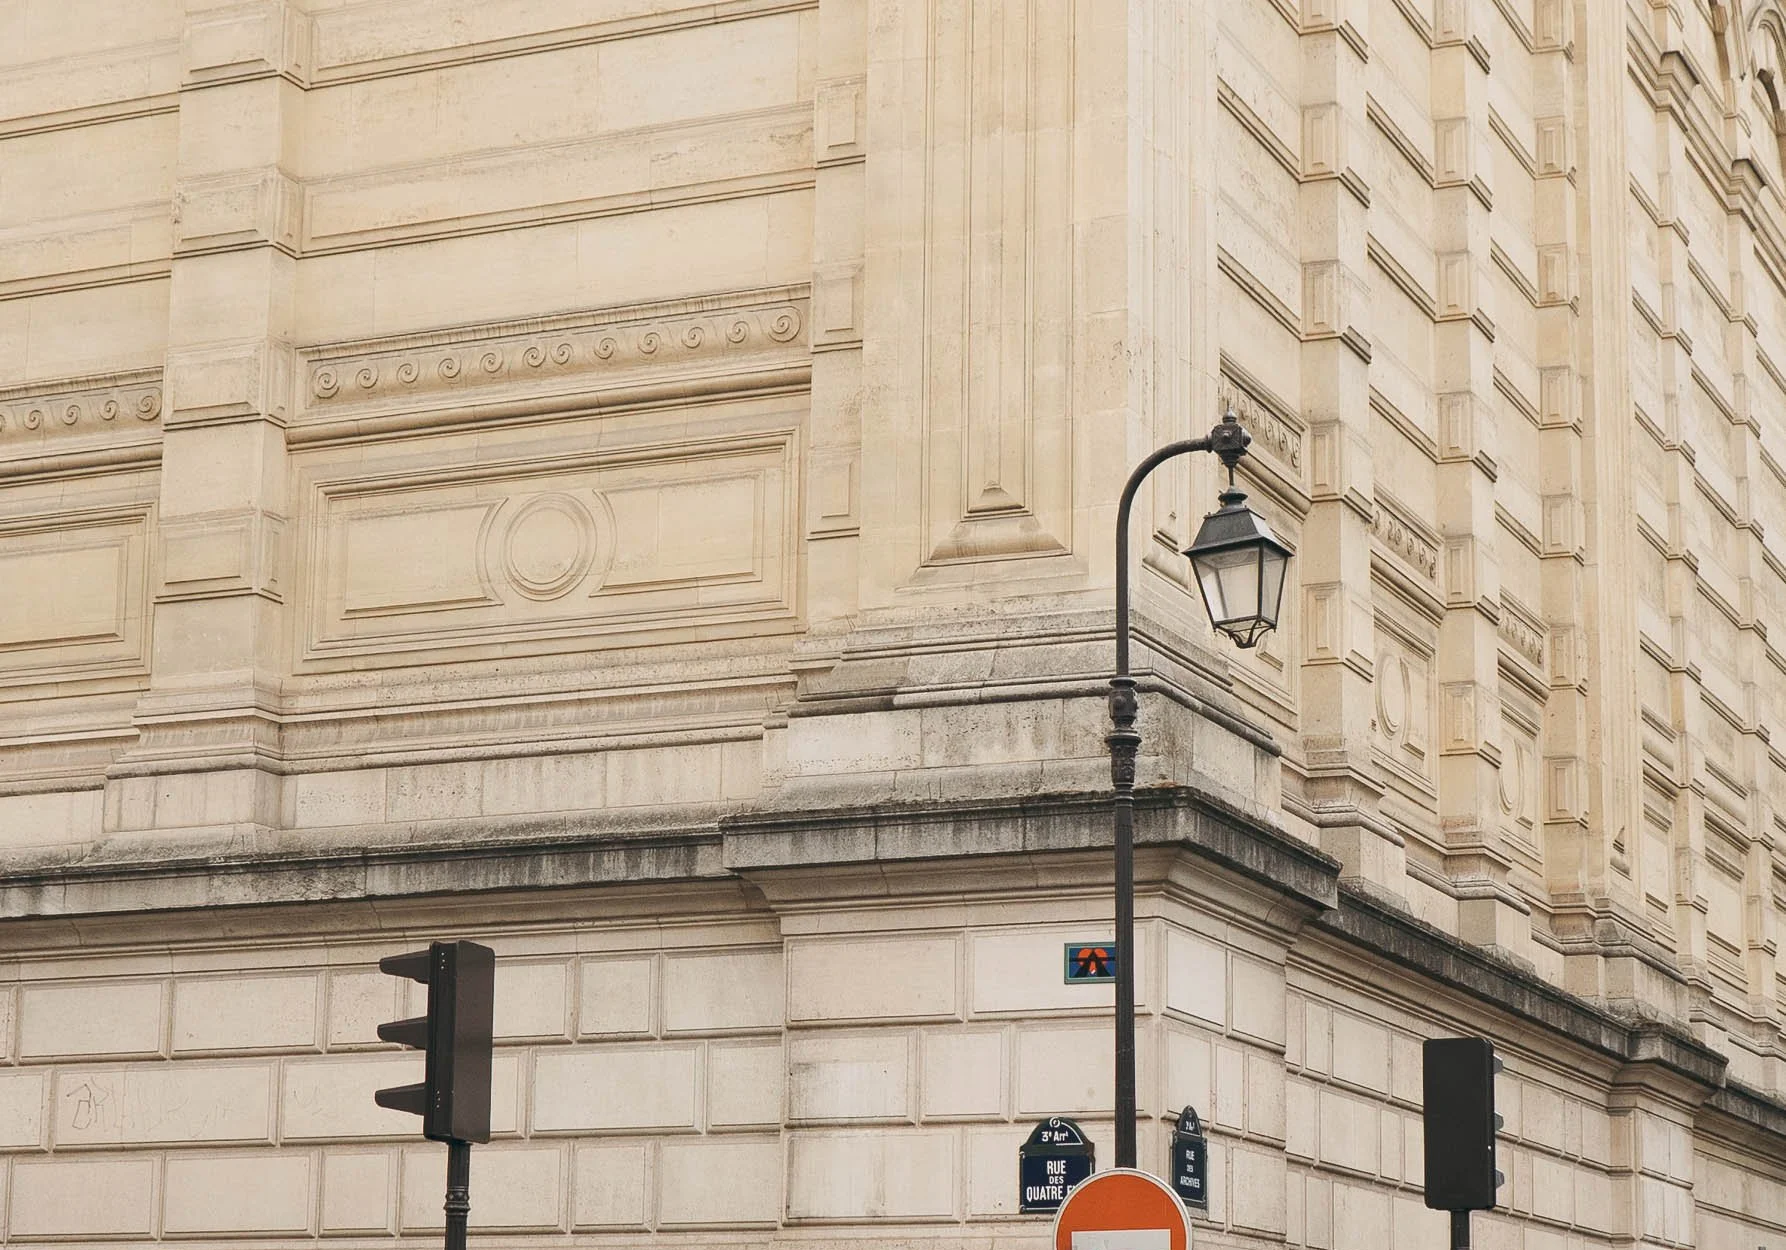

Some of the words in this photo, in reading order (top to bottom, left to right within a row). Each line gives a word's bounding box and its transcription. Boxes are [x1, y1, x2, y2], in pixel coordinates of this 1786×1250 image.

[1186, 1149, 1195, 1161] RUE
[1046, 1160, 1067, 1175] RUE
[1049, 1175, 1064, 1185] DES
[1179, 1175, 1200, 1189] ARCHIVES
[1026, 1185, 1064, 1202] QUATRE
